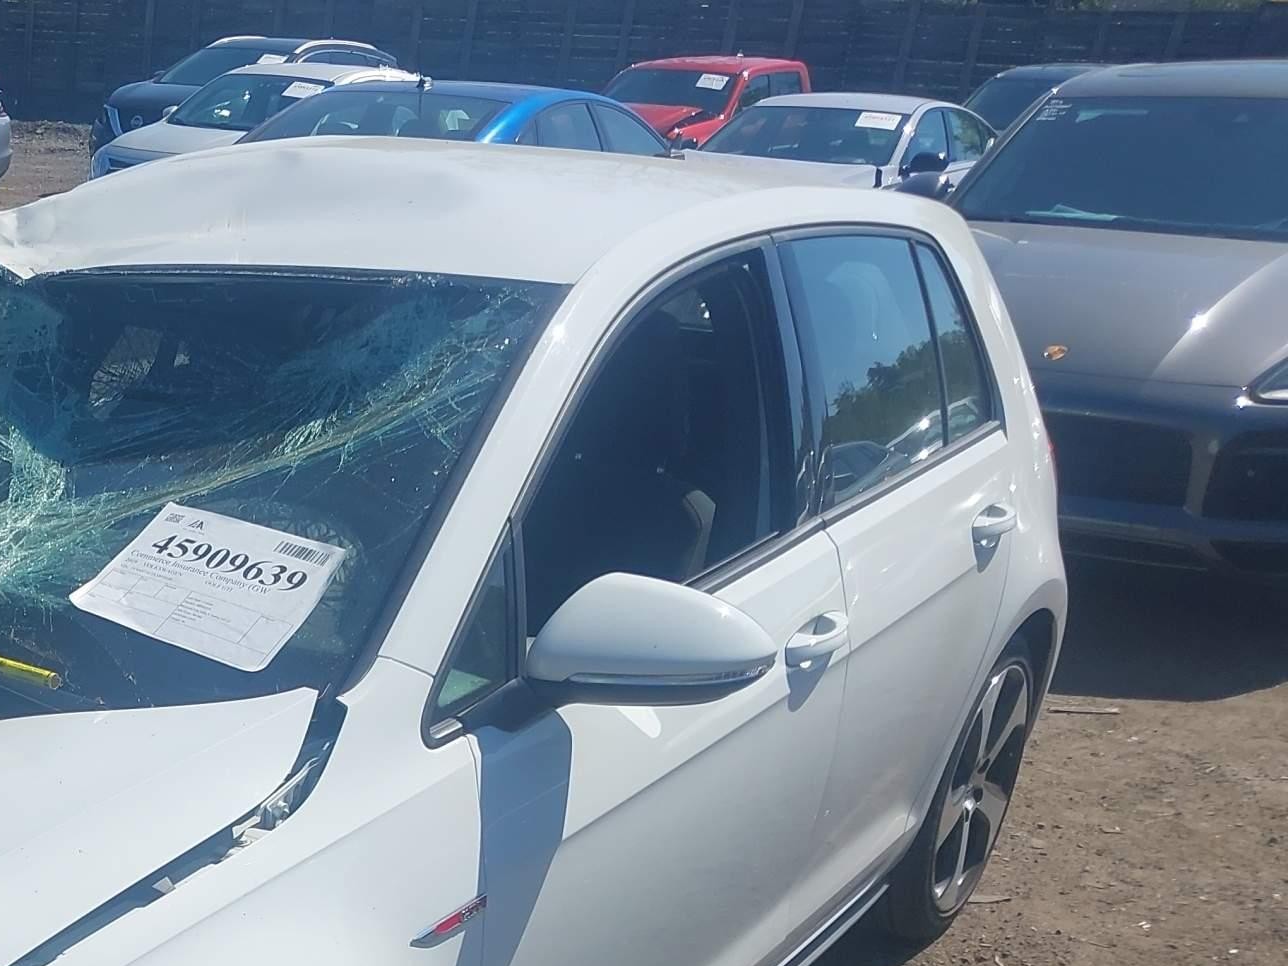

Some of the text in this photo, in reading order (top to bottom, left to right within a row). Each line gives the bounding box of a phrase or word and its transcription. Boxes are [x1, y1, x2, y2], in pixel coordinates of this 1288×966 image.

[131, 549, 172, 565] Commerce
[172, 560, 209, 577] Insurance
[210, 572, 248, 588] Company
[152, 535, 308, 591] 45909639
